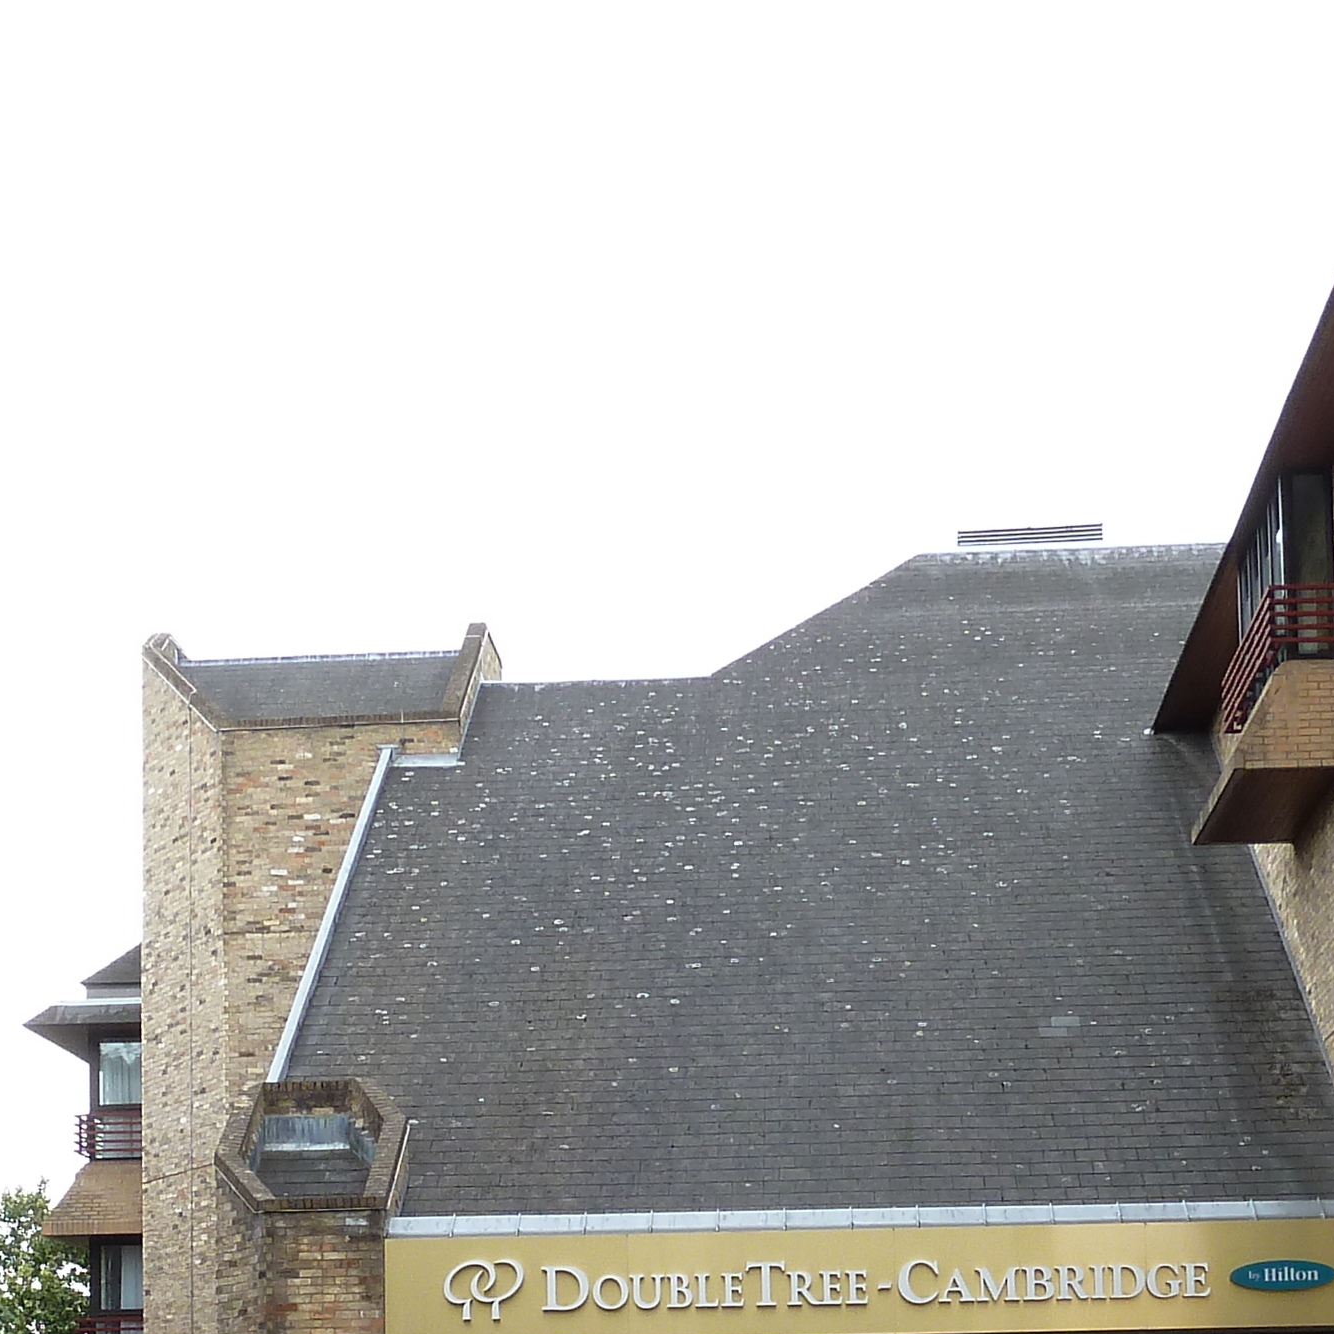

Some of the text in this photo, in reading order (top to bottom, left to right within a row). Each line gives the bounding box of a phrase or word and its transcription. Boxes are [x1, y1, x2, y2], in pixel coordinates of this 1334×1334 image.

[897, 1259, 1212, 1306] CAMBRIDGE
[1248, 1266, 1319, 1282] by Hilton
